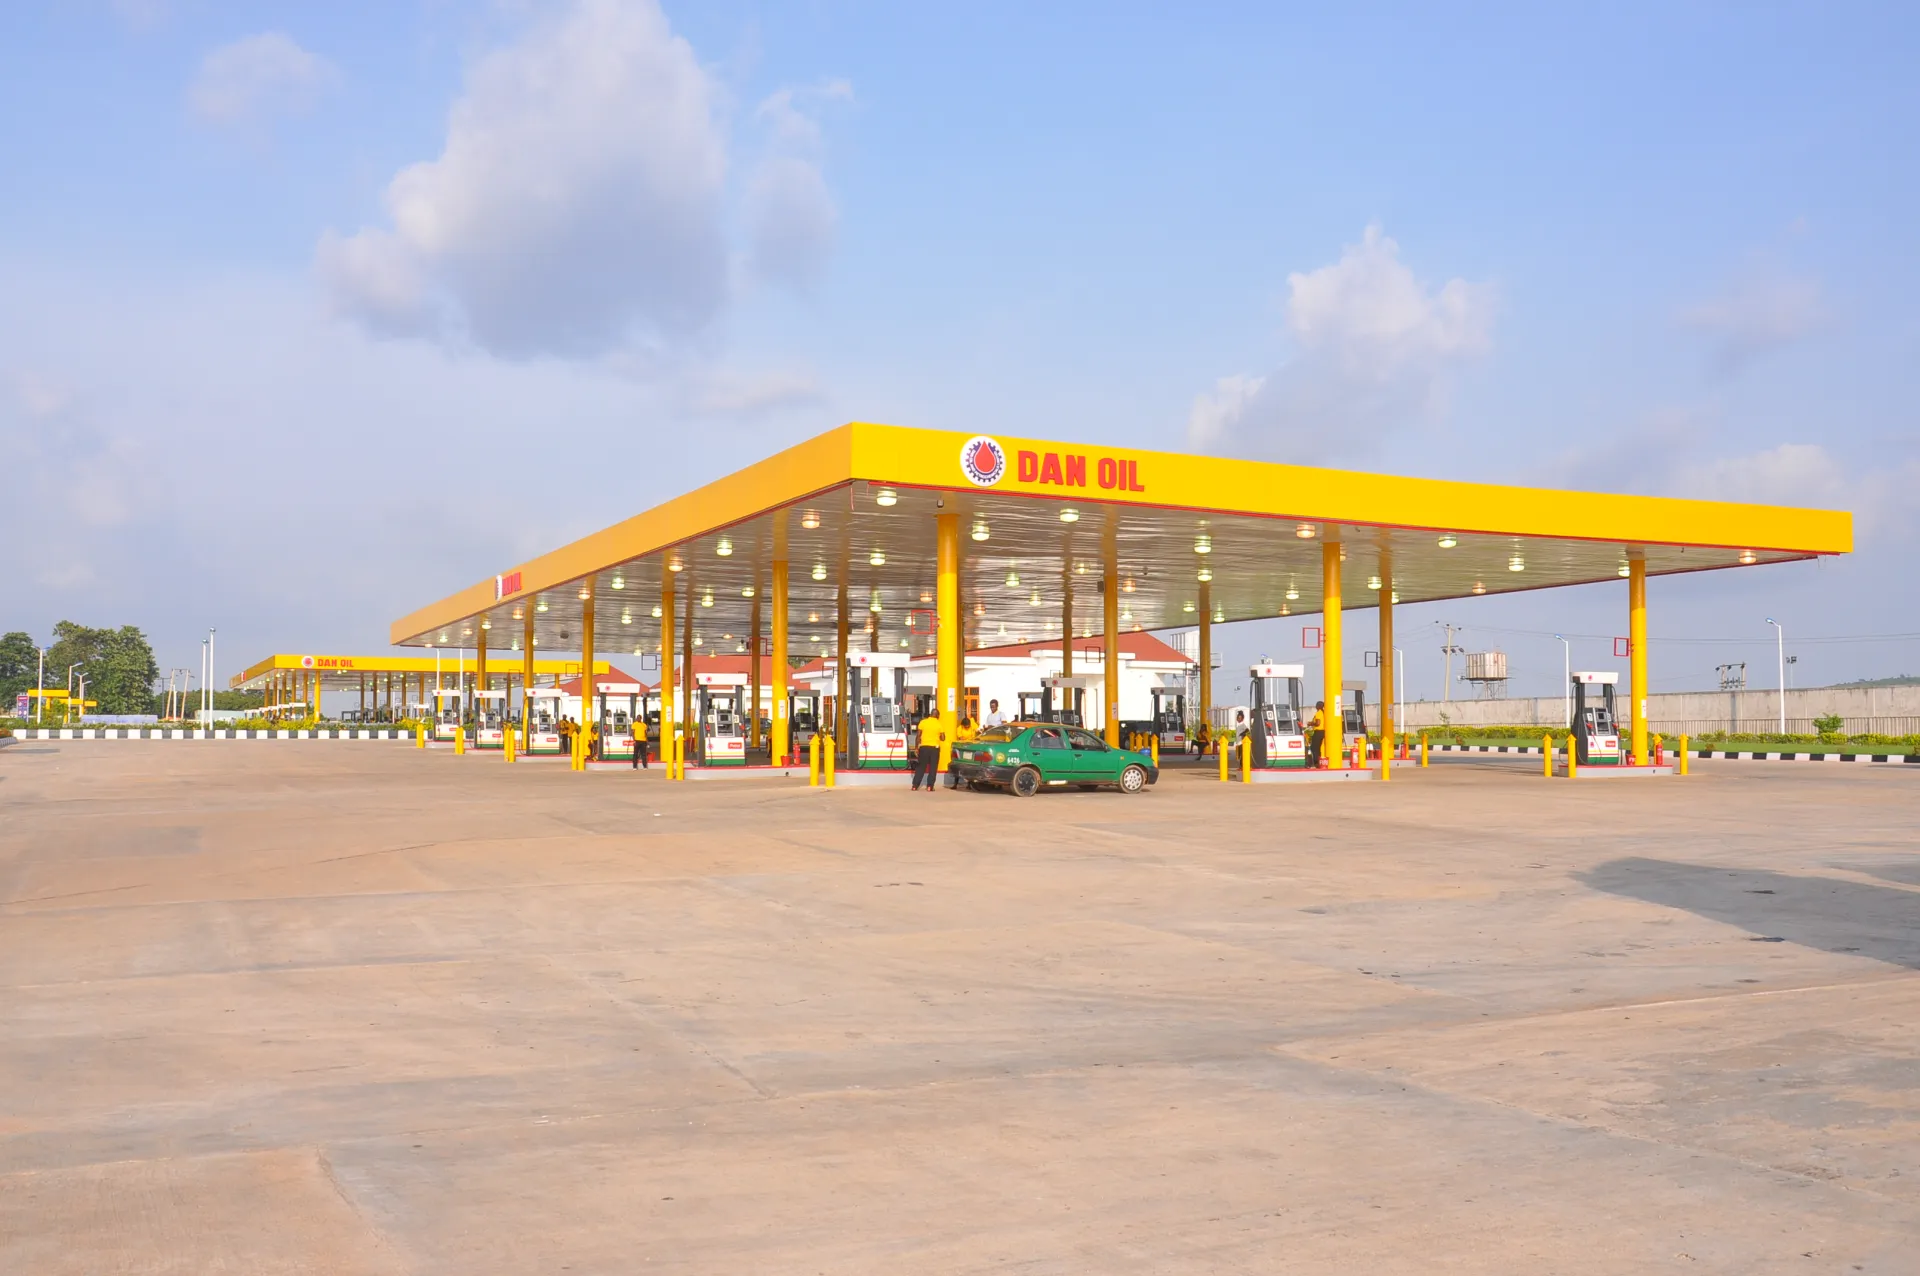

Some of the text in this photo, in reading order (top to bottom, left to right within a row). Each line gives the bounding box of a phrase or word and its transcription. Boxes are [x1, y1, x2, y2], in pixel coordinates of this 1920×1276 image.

[1018, 450, 1145, 492] DAN OIL
[317, 658, 354, 668] DAN OIL
